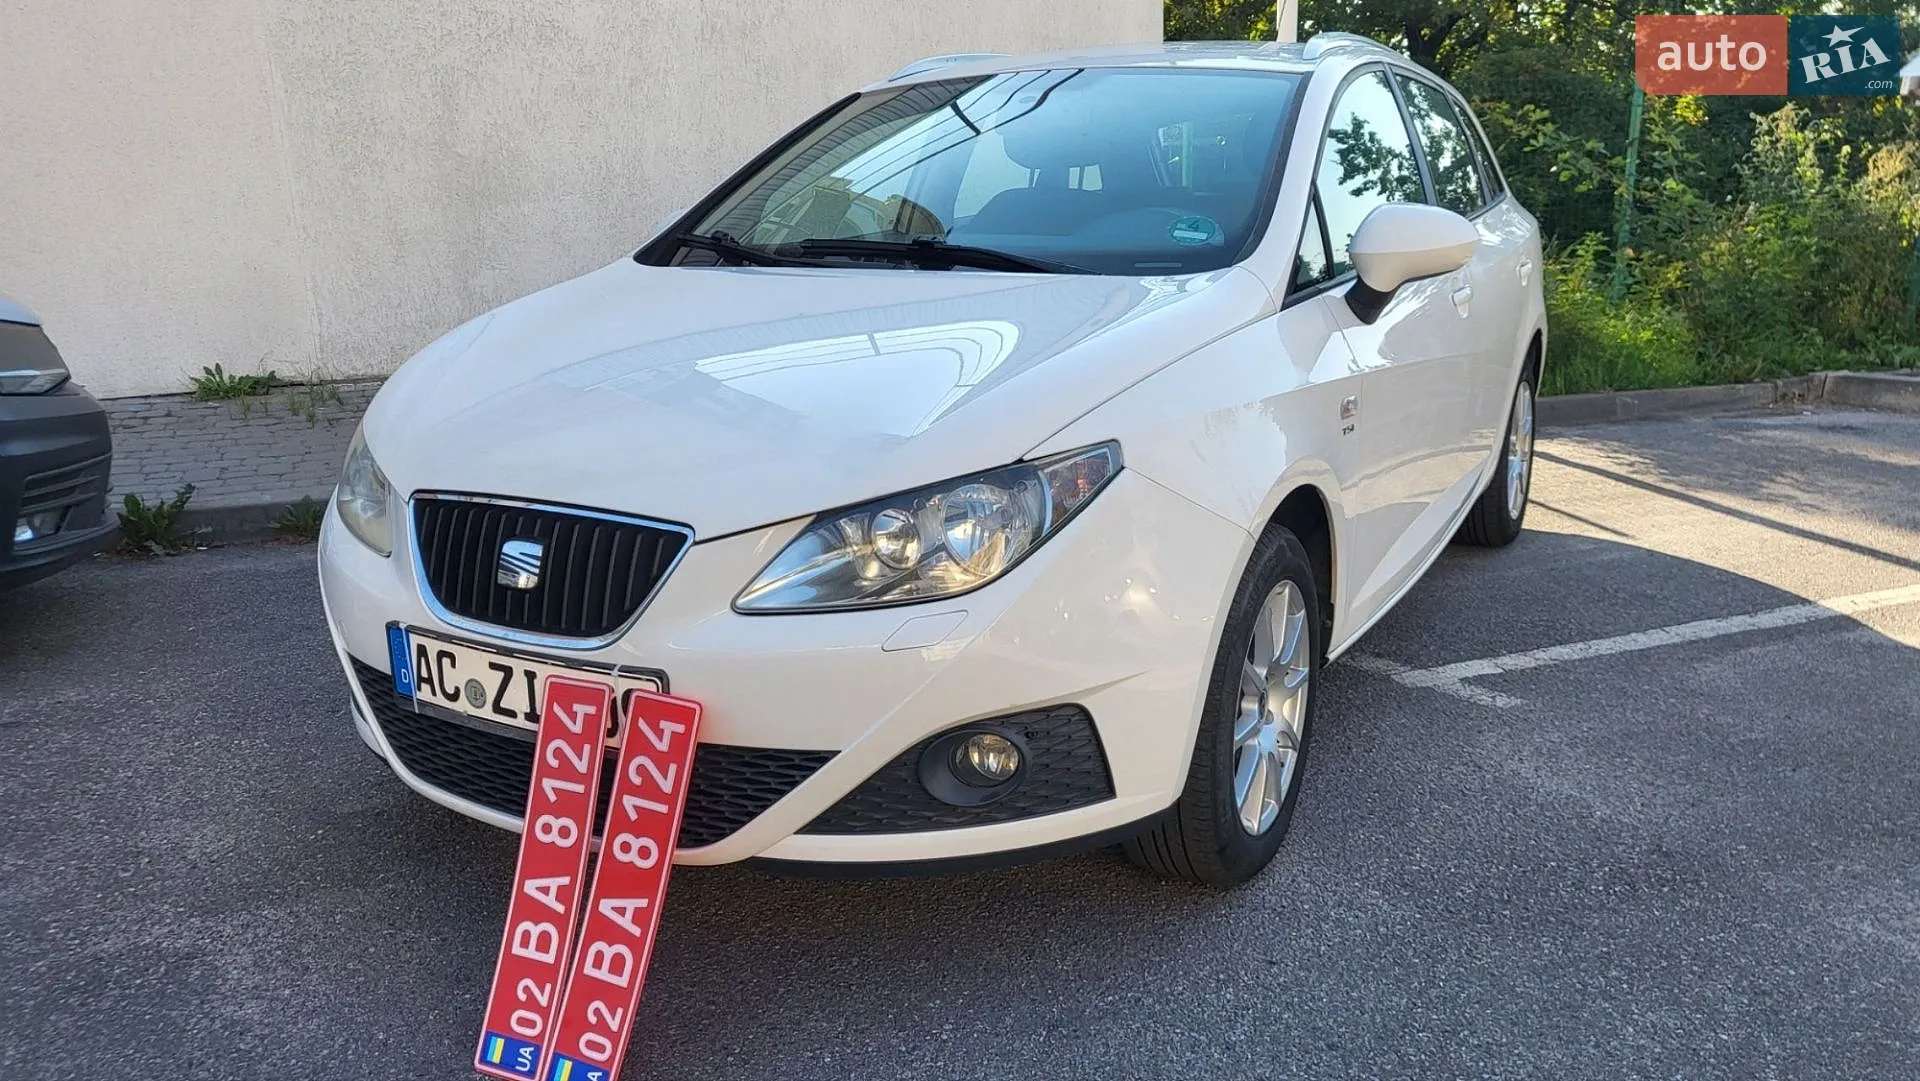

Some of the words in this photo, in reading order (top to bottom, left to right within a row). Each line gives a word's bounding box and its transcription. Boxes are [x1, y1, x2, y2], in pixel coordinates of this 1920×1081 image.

[416, 643, 461, 702] AC
[534, 701, 598, 848] 8124
[612, 717, 686, 870] 8124
[511, 876, 571, 964] BA
[583, 898, 649, 988] BA
[510, 977, 552, 1037] 02
[578, 1000, 624, 1062] 02
[515, 1046, 535, 1073] UA
